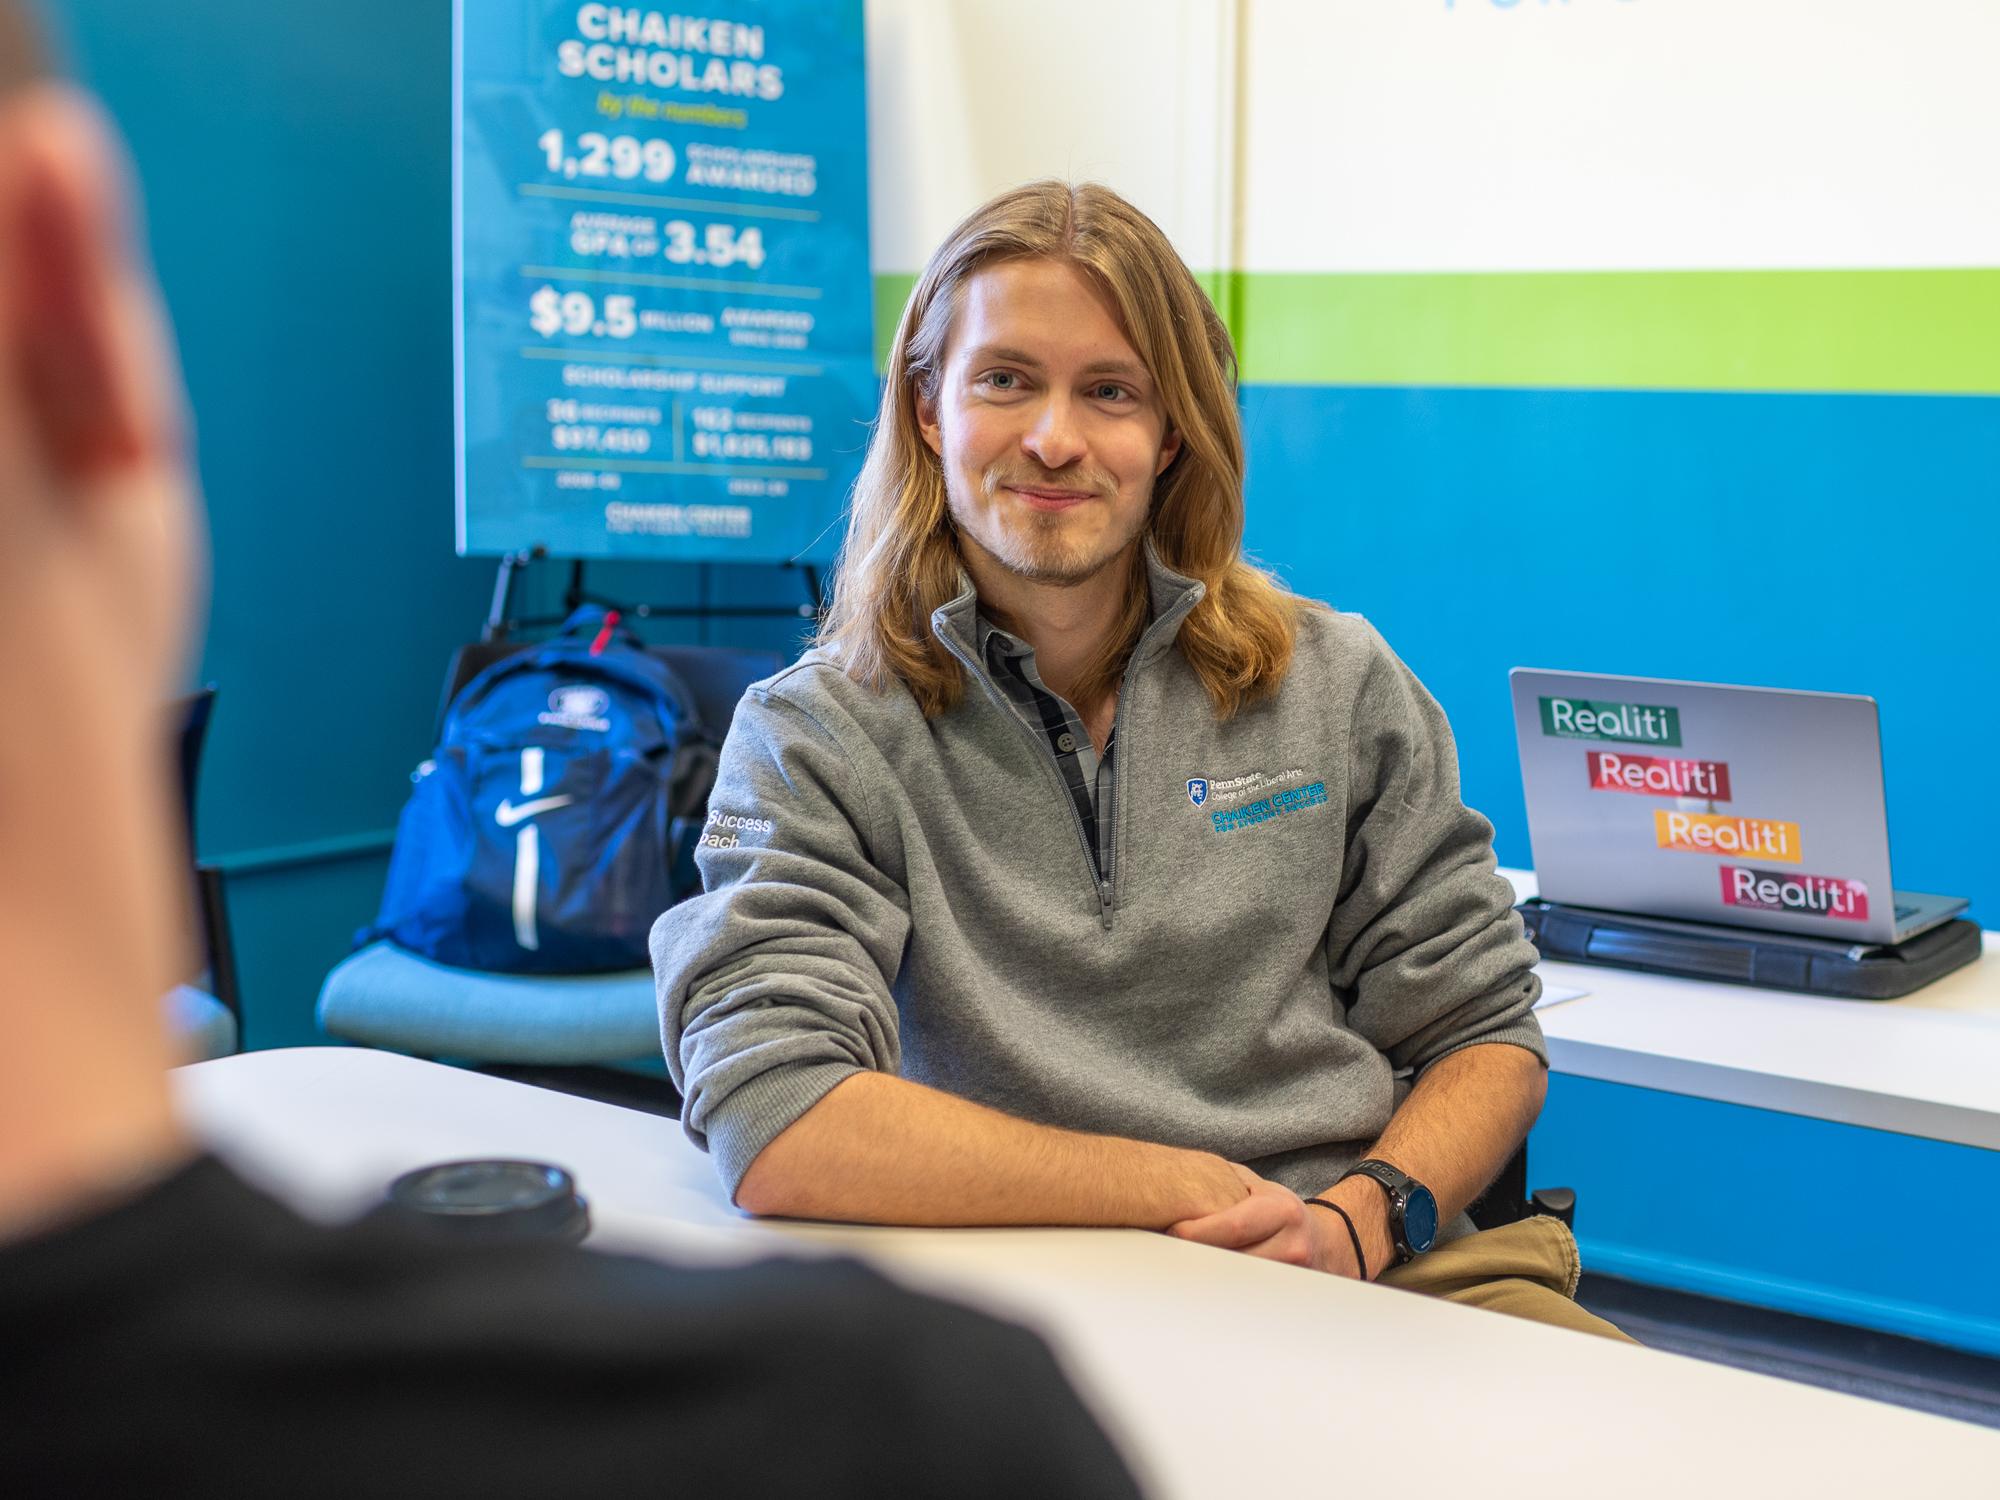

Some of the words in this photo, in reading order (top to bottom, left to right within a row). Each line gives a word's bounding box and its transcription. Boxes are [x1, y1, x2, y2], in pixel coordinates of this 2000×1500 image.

[577, 2, 764, 60] CHAIKEN
[558, 39, 784, 101] SCHOLARS
[538, 128, 676, 182] 1,299
[685, 164, 817, 197] AWARDED
[664, 220, 767, 269] 3.54
[531, 284, 637, 338] $9.5
[1551, 699, 1668, 739] Realiti
[1211, 791, 1237, 801] College
[1260, 772, 1285, 789] Liberal
[1286, 768, 1304, 780] Arts
[1599, 753, 1718, 795] Realiti
[707, 809, 772, 832] Success
[1211, 799, 1271, 824] CHAIKEN
[1272, 783, 1326, 807] CENTER
[699, 833, 740, 849] oach
[1667, 812, 1788, 855] Realiti
[1733, 868, 1855, 913] Realiti
